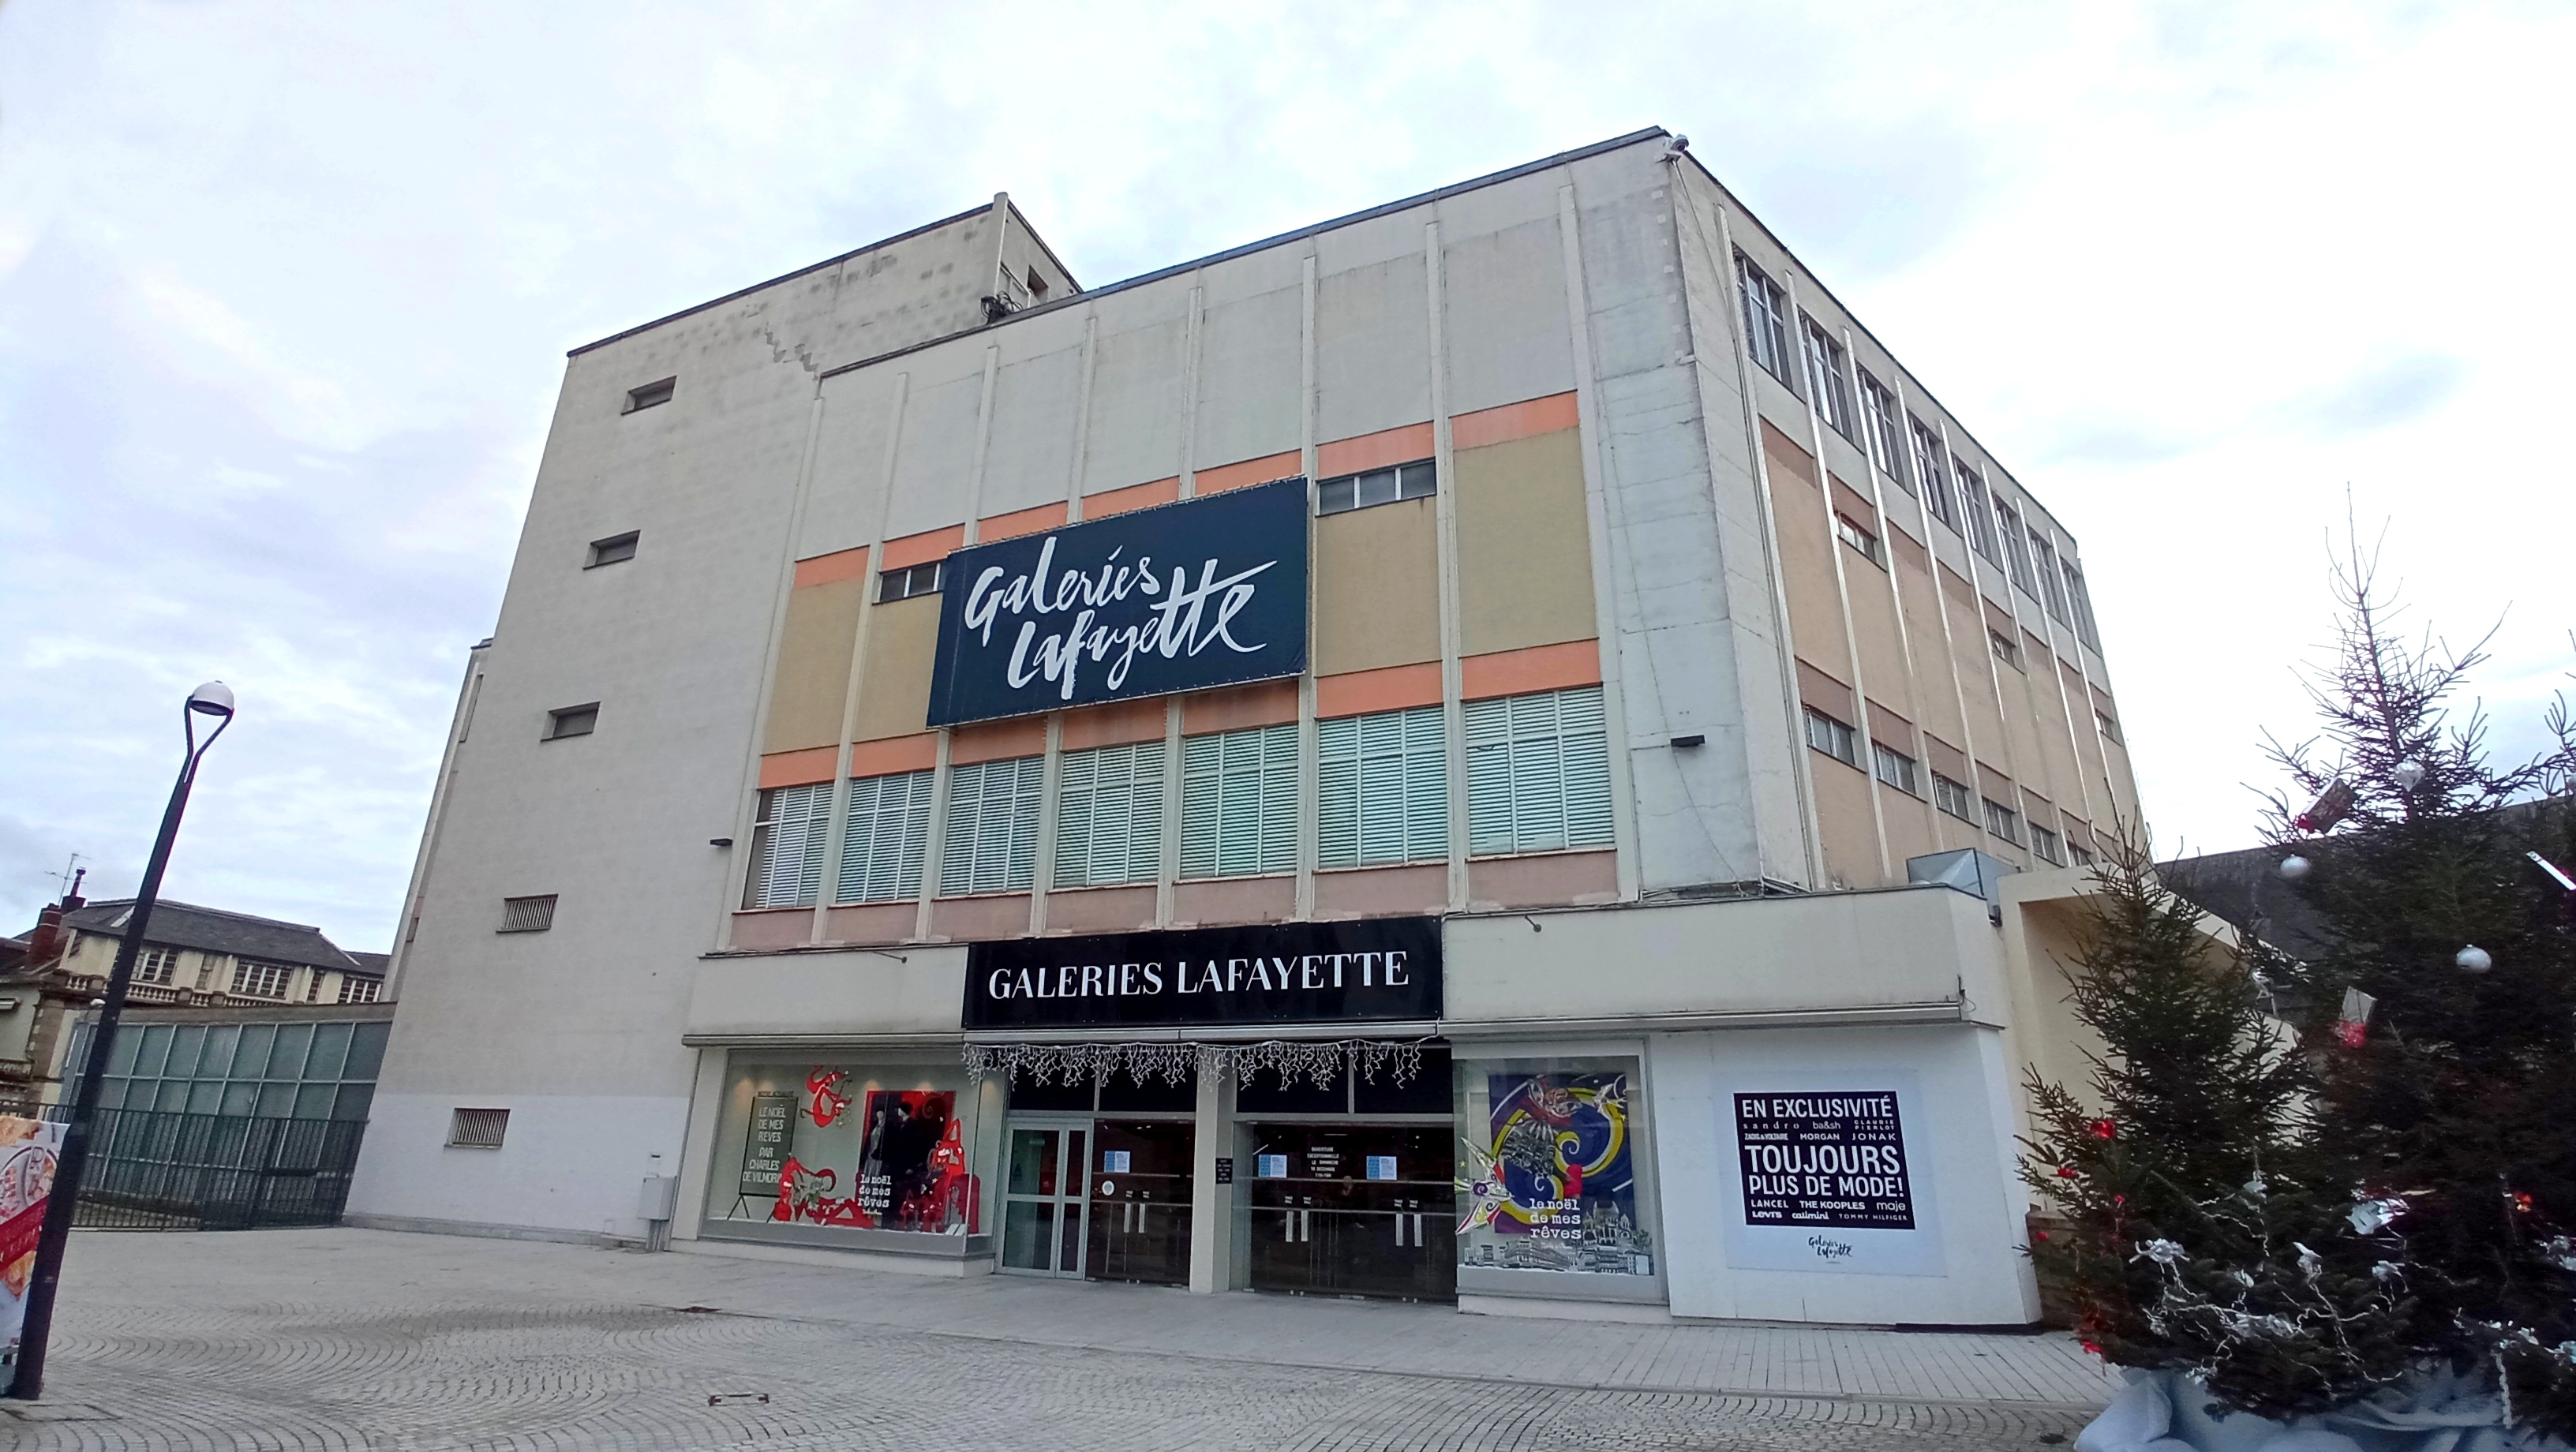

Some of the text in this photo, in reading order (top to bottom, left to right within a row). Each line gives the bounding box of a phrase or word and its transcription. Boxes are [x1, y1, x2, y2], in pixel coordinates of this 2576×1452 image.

[964, 537, 1161, 647] Galeries
[1007, 559, 1277, 700] Lafayette
[989, 951, 1410, 1000] GALERIES LAFAYETTE
[759, 1107, 767, 1117] LE
[1742, 1095, 1893, 1118] EN EXCLUSIVITÉ
[769, 1120, 784, 1130] MES
[1743, 1120, 1800, 1129] sandro
[749, 1159, 780, 1170] CHARLES
[1745, 1145, 1900, 1174] TOUJOURS
[743, 1171, 751, 1182] DE
[860, 1174, 892, 1184] le noël
[859, 1185, 871, 1195] de
[1749, 1175, 1904, 1197] PLUS DE MODE!
[857, 1196, 889, 1207] rêves
[1530, 1198, 1580, 1211] le noël
[1751, 1199, 1788, 1208] LANCEL
[1820, 1201, 1865, 1210] KOOPLES
[1877, 1200, 1906, 1212] maje
[1530, 1211, 1581, 1224] de mes
[1530, 1226, 1582, 1239] rêves
